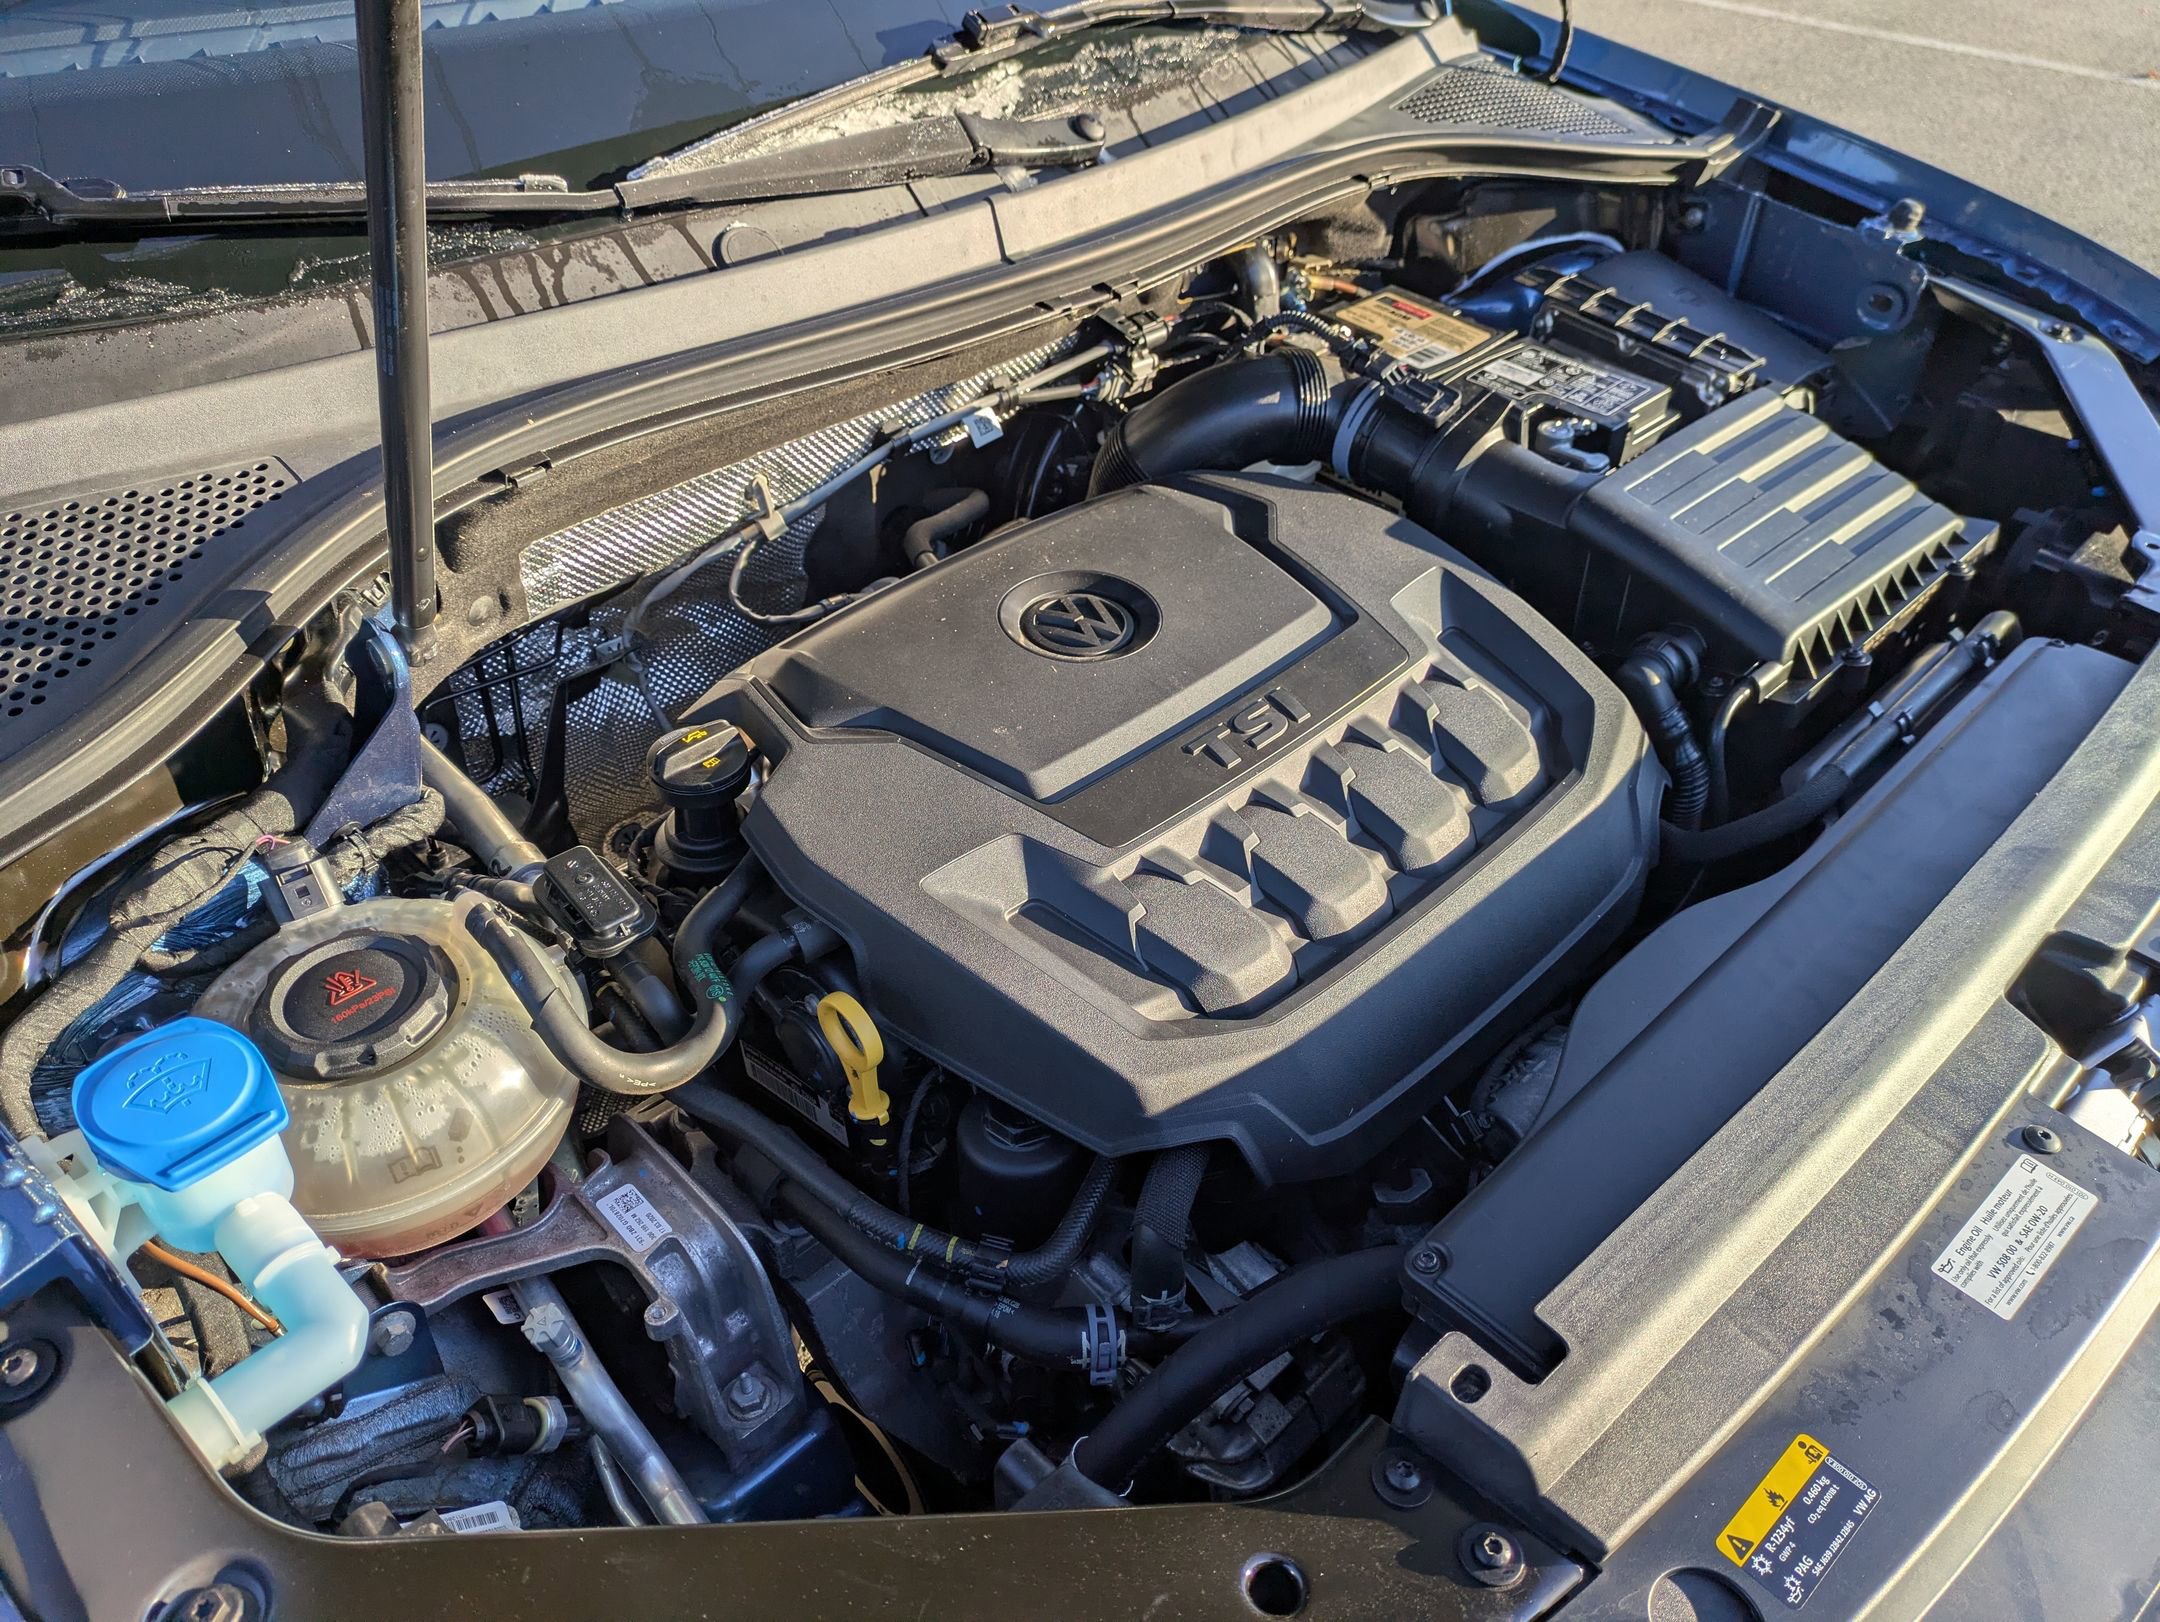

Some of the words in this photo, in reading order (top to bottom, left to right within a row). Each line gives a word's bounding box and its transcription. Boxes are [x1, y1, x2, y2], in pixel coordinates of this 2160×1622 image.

[1183, 687, 1311, 770] TSI
[1980, 1209, 1997, 1225] Huile
[1993, 1189, 2012, 1210] moteur
[1955, 1236, 1976, 1256] Engine
[1971, 1225, 1983, 1236] Oil
[1987, 1265, 2001, 1278] VW
[1996, 1253, 2011, 1267] 508
[2006, 1244, 2017, 1255] 00
[2019, 1224, 2033, 1238] SAE
[2028, 1205, 2047, 1226] 0W-20
[1958, 1265, 1969, 1275] only
[1968, 1251, 1979, 1261] that
[1976, 1234, 1993, 1252] expressly
[1974, 1260, 1984, 1270] with
[2002, 1263, 2019, 1284] approved
[1820, 1487, 1836, 1506] 0.0018
[1853, 1499, 1868, 1515] VW
[1864, 1489, 1876, 1503] AG
[1765, 1516, 1794, 1552] R-1234yf
[1803, 1484, 1821, 1504] 0.460
[1816, 1476, 1830, 1486] kg
[1816, 1505, 1826, 1514] eq
[1779, 1546, 1791, 1561] GWP
[1794, 1555, 1813, 1576] PAG
[1812, 1562, 1824, 1576] SAE
